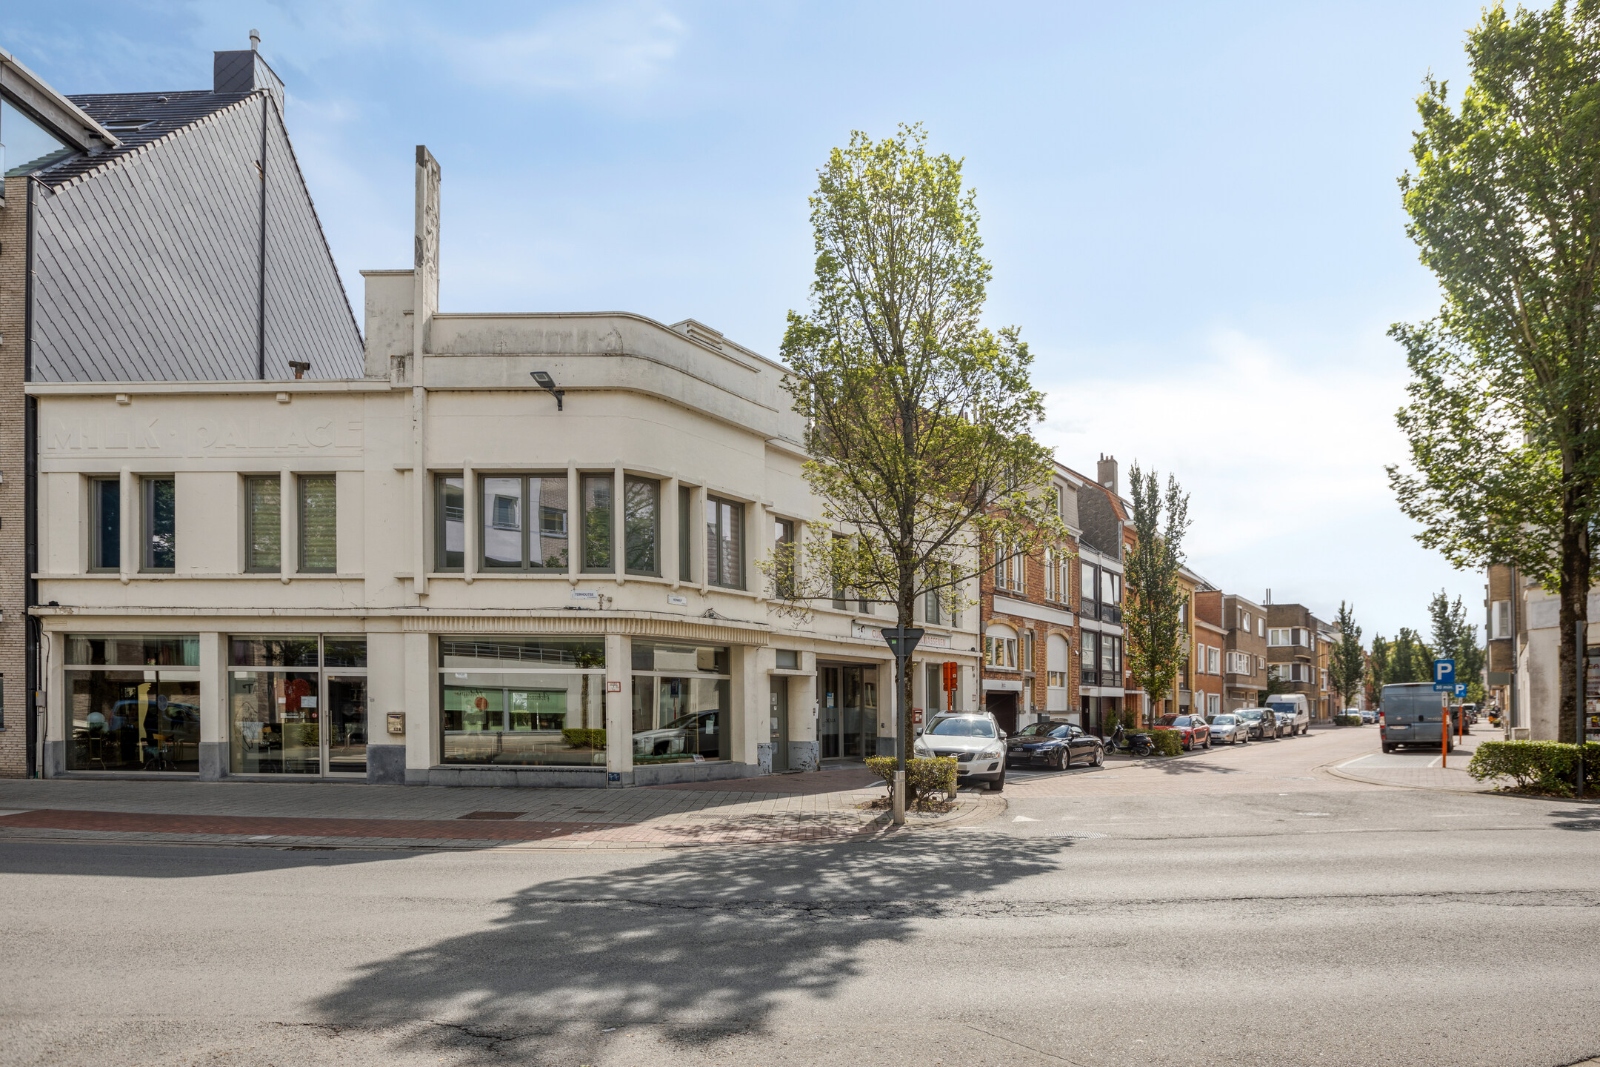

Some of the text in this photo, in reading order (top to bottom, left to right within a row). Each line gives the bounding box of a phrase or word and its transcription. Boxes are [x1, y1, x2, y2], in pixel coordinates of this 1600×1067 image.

[47, 417, 362, 449] MILK PALACE
[1437, 663, 1452, 680] P
[1455, 684, 1464, 694] P
